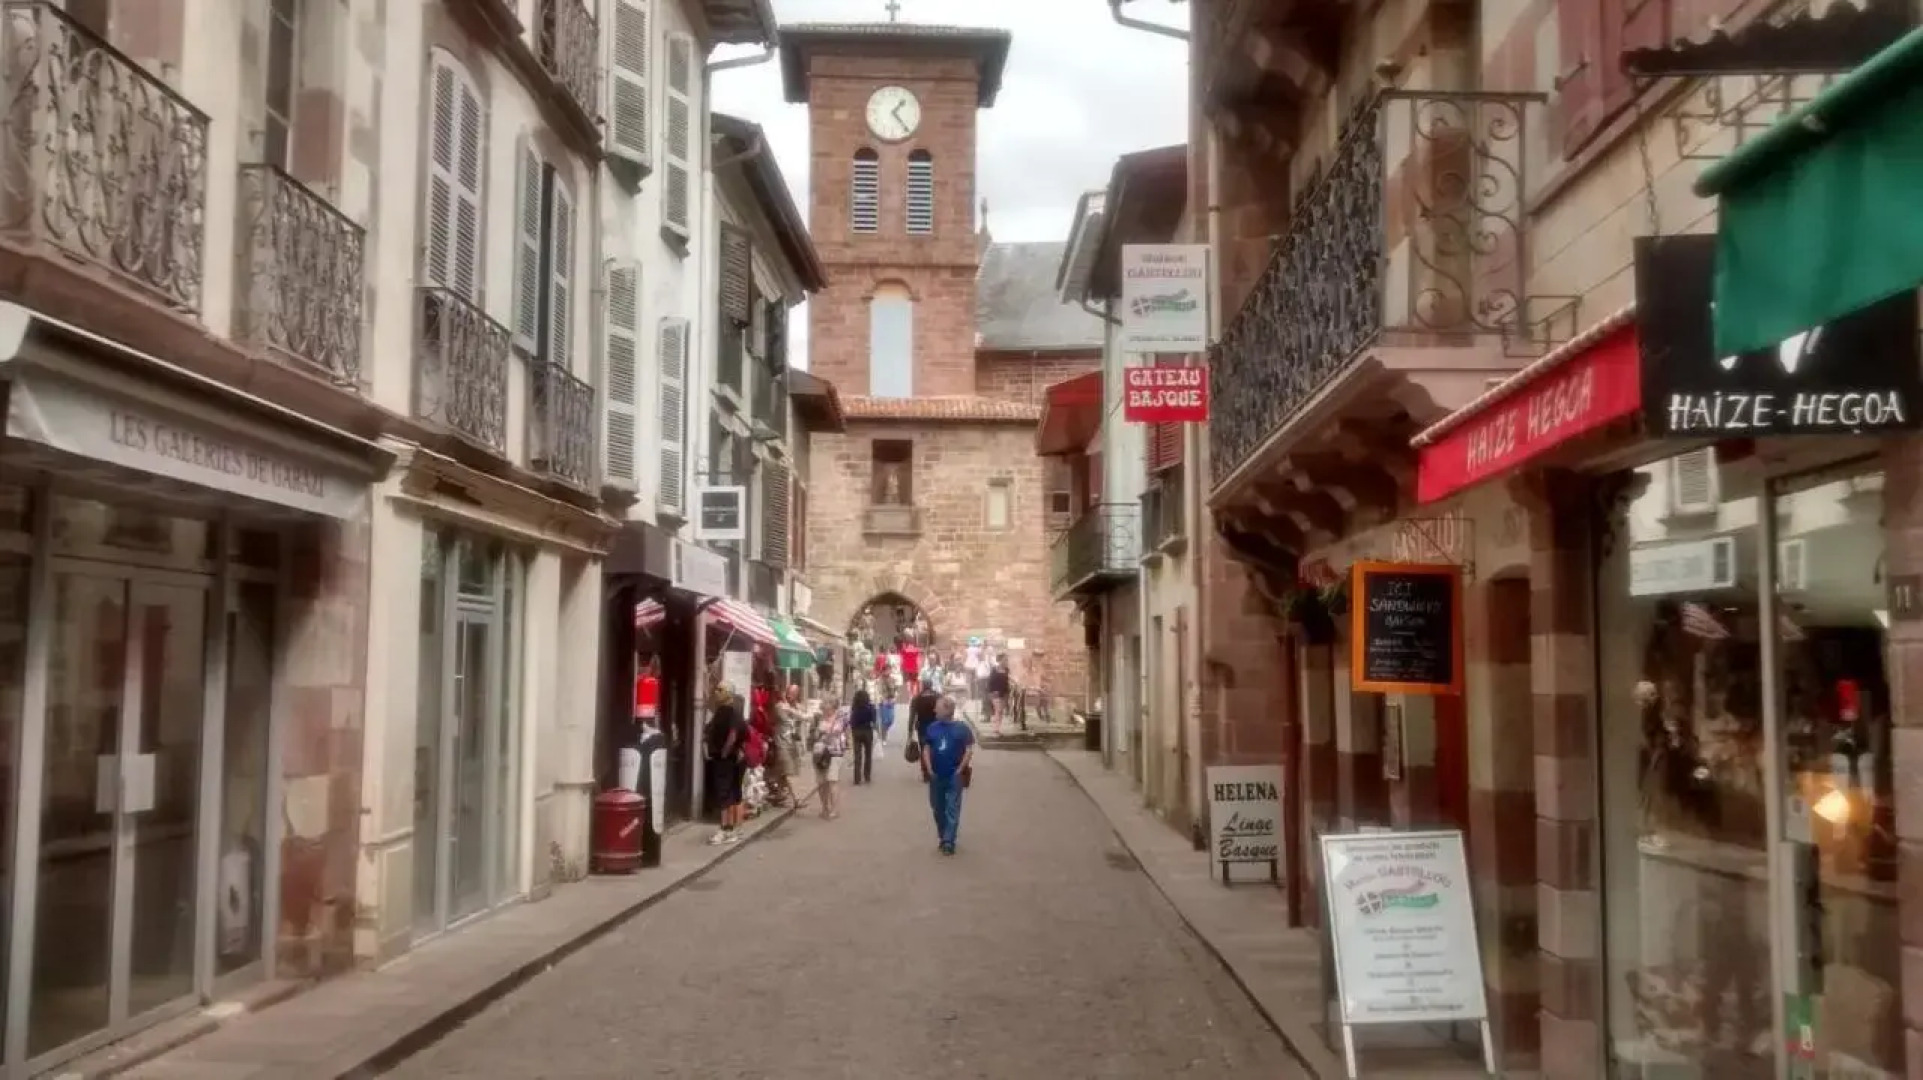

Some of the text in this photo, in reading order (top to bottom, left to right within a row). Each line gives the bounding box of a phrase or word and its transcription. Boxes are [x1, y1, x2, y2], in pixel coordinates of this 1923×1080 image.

[1129, 370, 1200, 387] GATEAU
[1129, 390, 1201, 408] BASQUE
[1467, 367, 1592, 473] HAIZE HEGOA
[109, 411, 147, 450] LES
[153, 425, 242, 476] GALERIES
[246, 451, 269, 483] DE
[1213, 782, 1278, 801] HELENA
[1222, 811, 1273, 835] Linge
[1219, 839, 1278, 862] Basque
